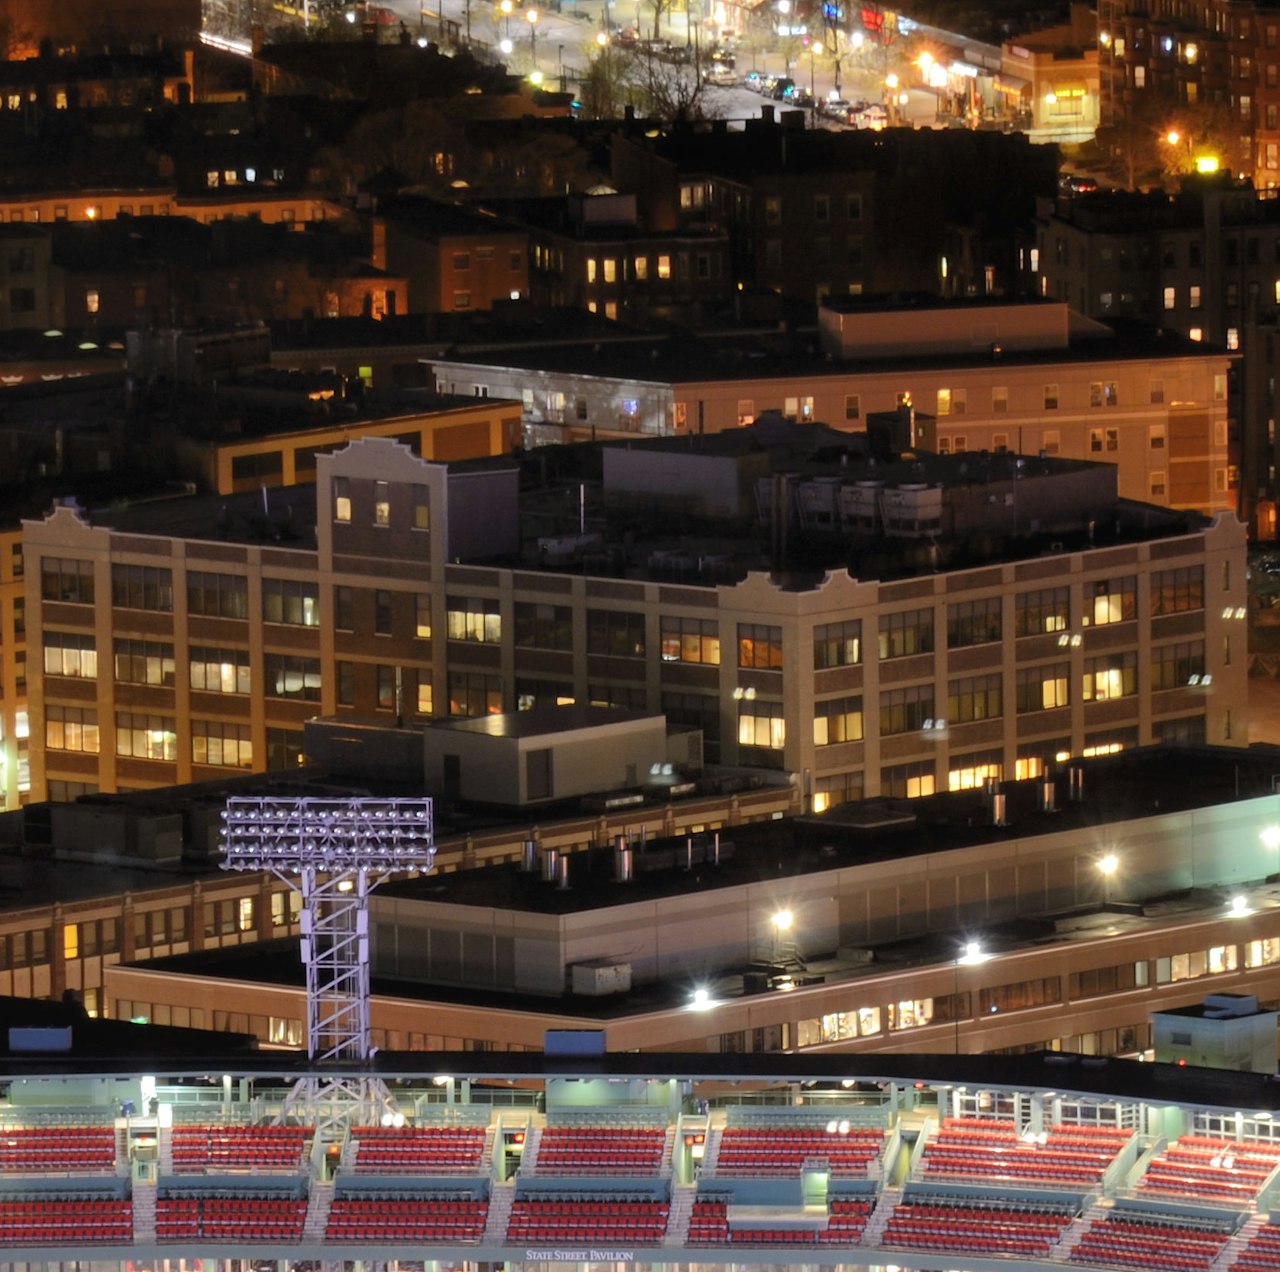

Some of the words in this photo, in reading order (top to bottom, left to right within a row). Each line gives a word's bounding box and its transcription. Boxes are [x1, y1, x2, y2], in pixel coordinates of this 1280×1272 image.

[526, 1250, 553, 1260] STATE
[554, 1250, 587, 1260] STREET
[589, 1249, 634, 1261] PAVILION
